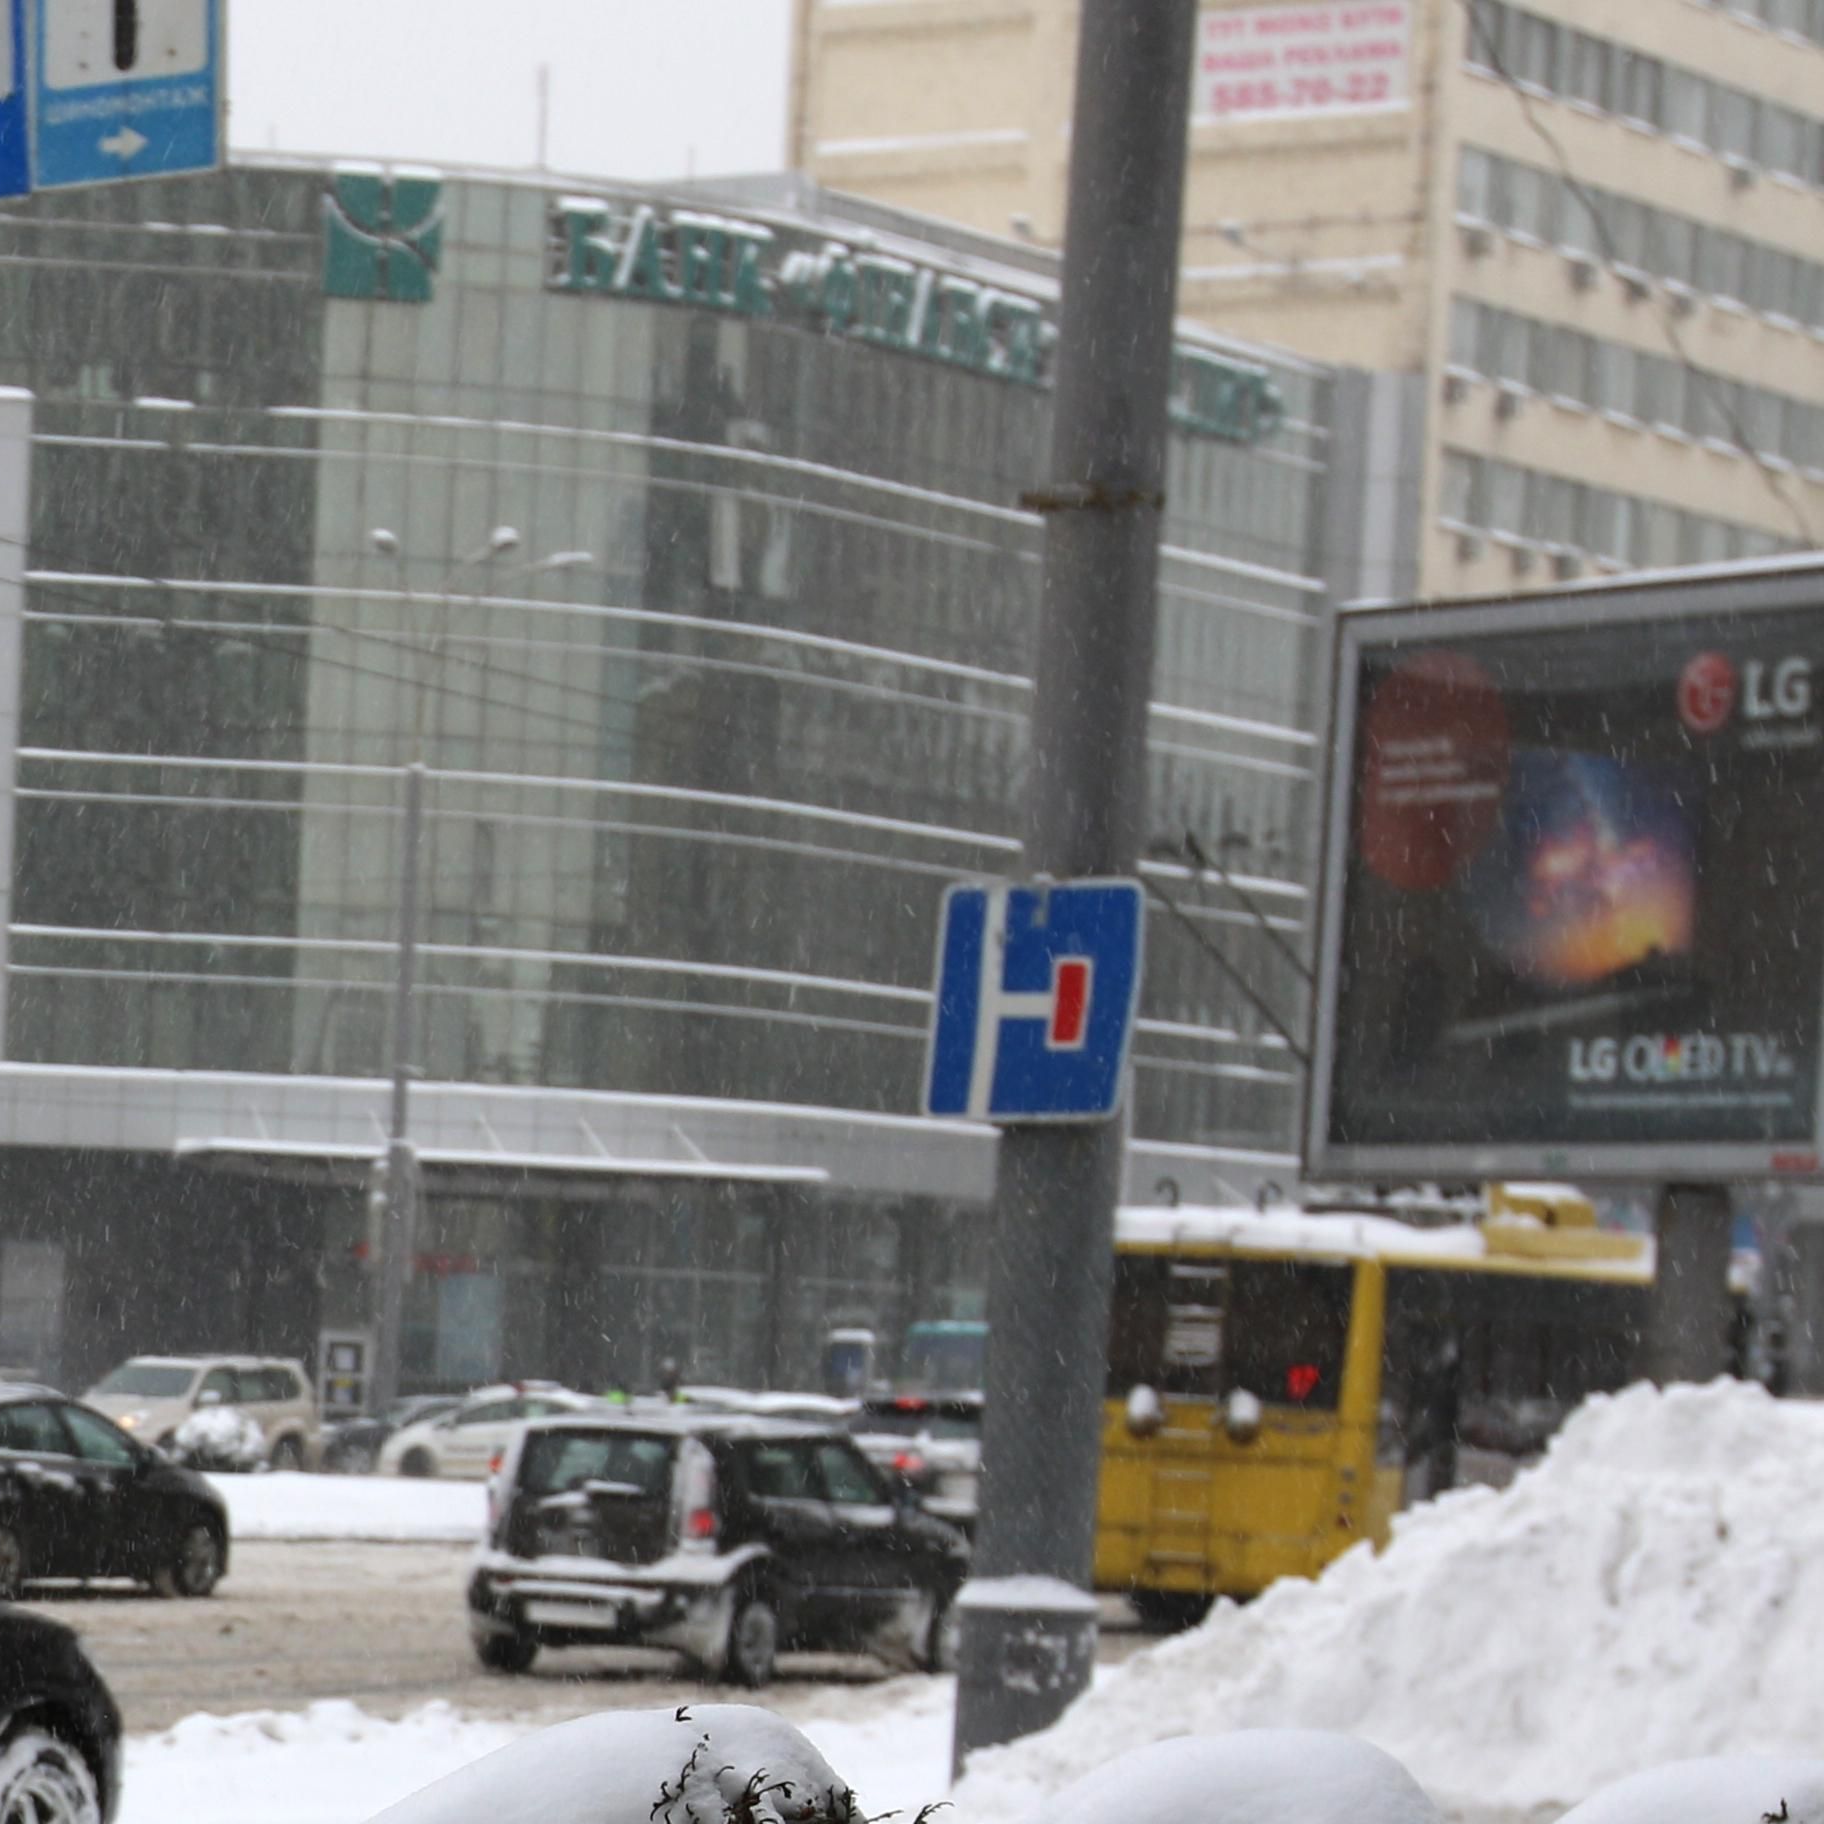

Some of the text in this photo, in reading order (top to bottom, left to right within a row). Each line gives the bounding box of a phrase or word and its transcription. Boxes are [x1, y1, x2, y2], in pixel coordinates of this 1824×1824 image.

[1743, 656, 1812, 718] LG
[1568, 1036, 1618, 1083] LG
[1622, 1032, 1726, 1083] OLED
